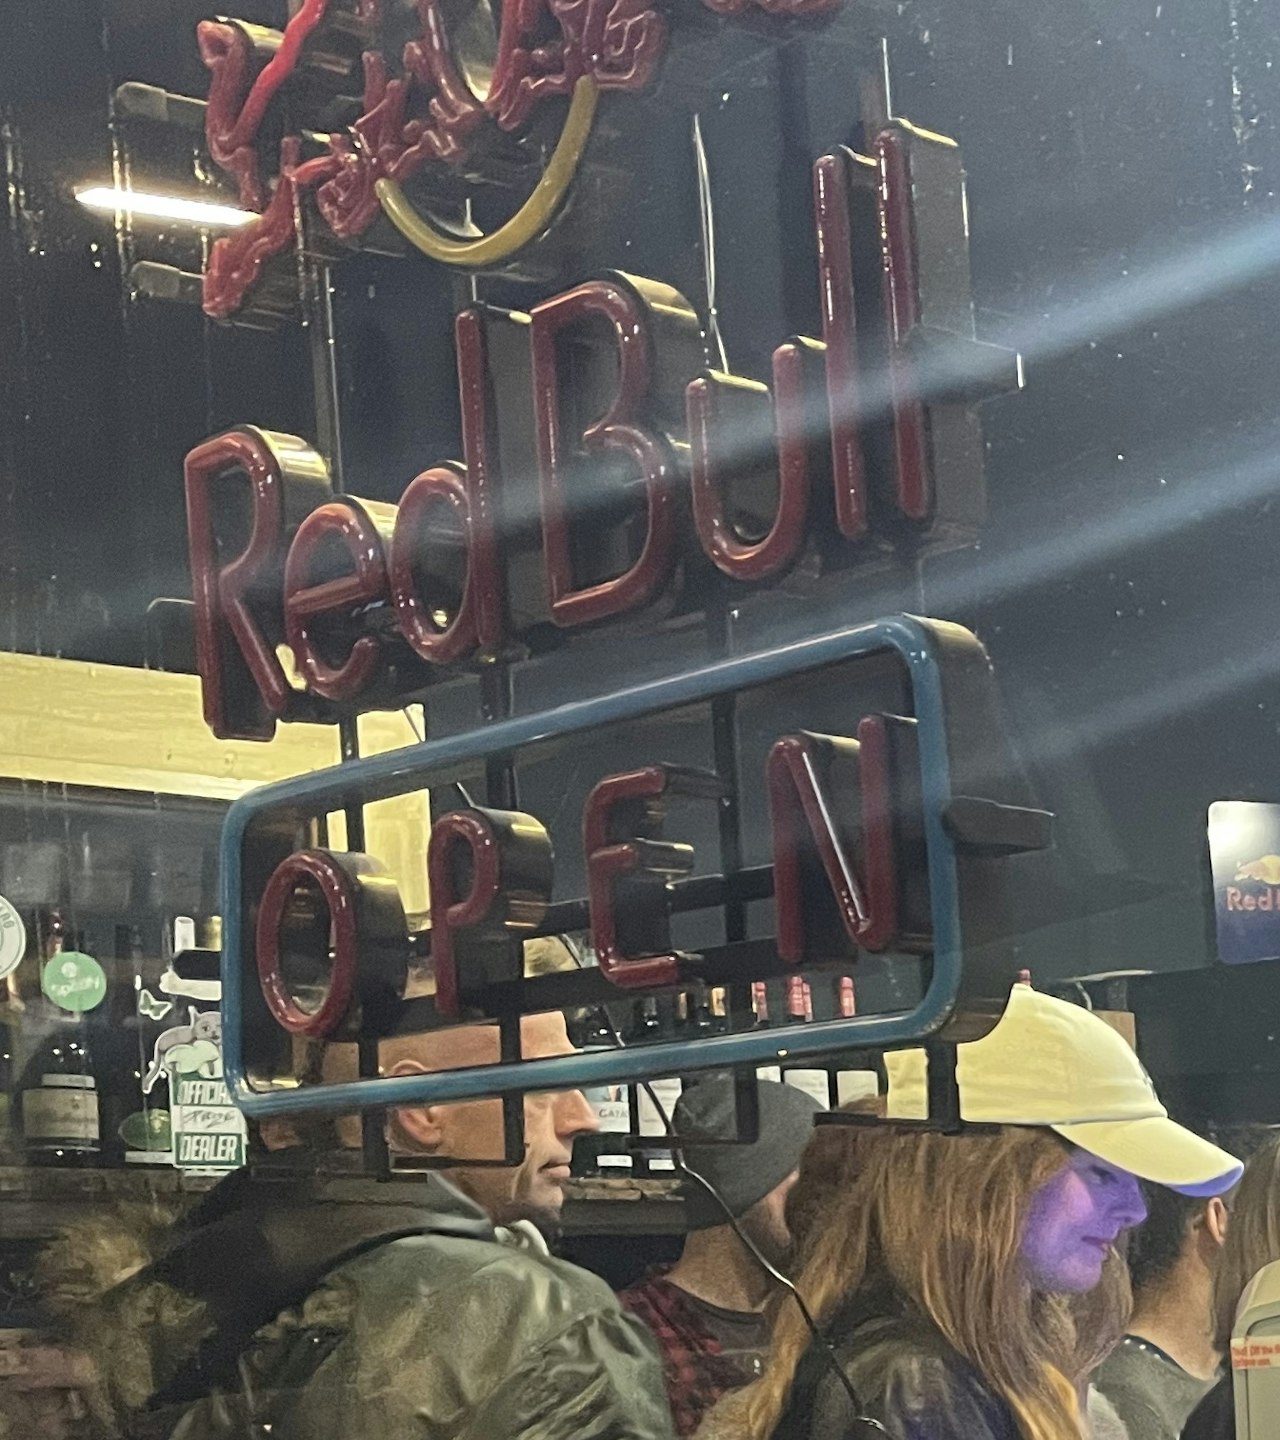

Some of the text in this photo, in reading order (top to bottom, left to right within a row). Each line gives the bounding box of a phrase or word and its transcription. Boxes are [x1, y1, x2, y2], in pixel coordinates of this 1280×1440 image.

[183, 125, 936, 741] Red Bull
[256, 712, 890, 1037] OPEN
[1226, 886, 1273, 913] Red
[179, 1134, 237, 1162] DEALER
